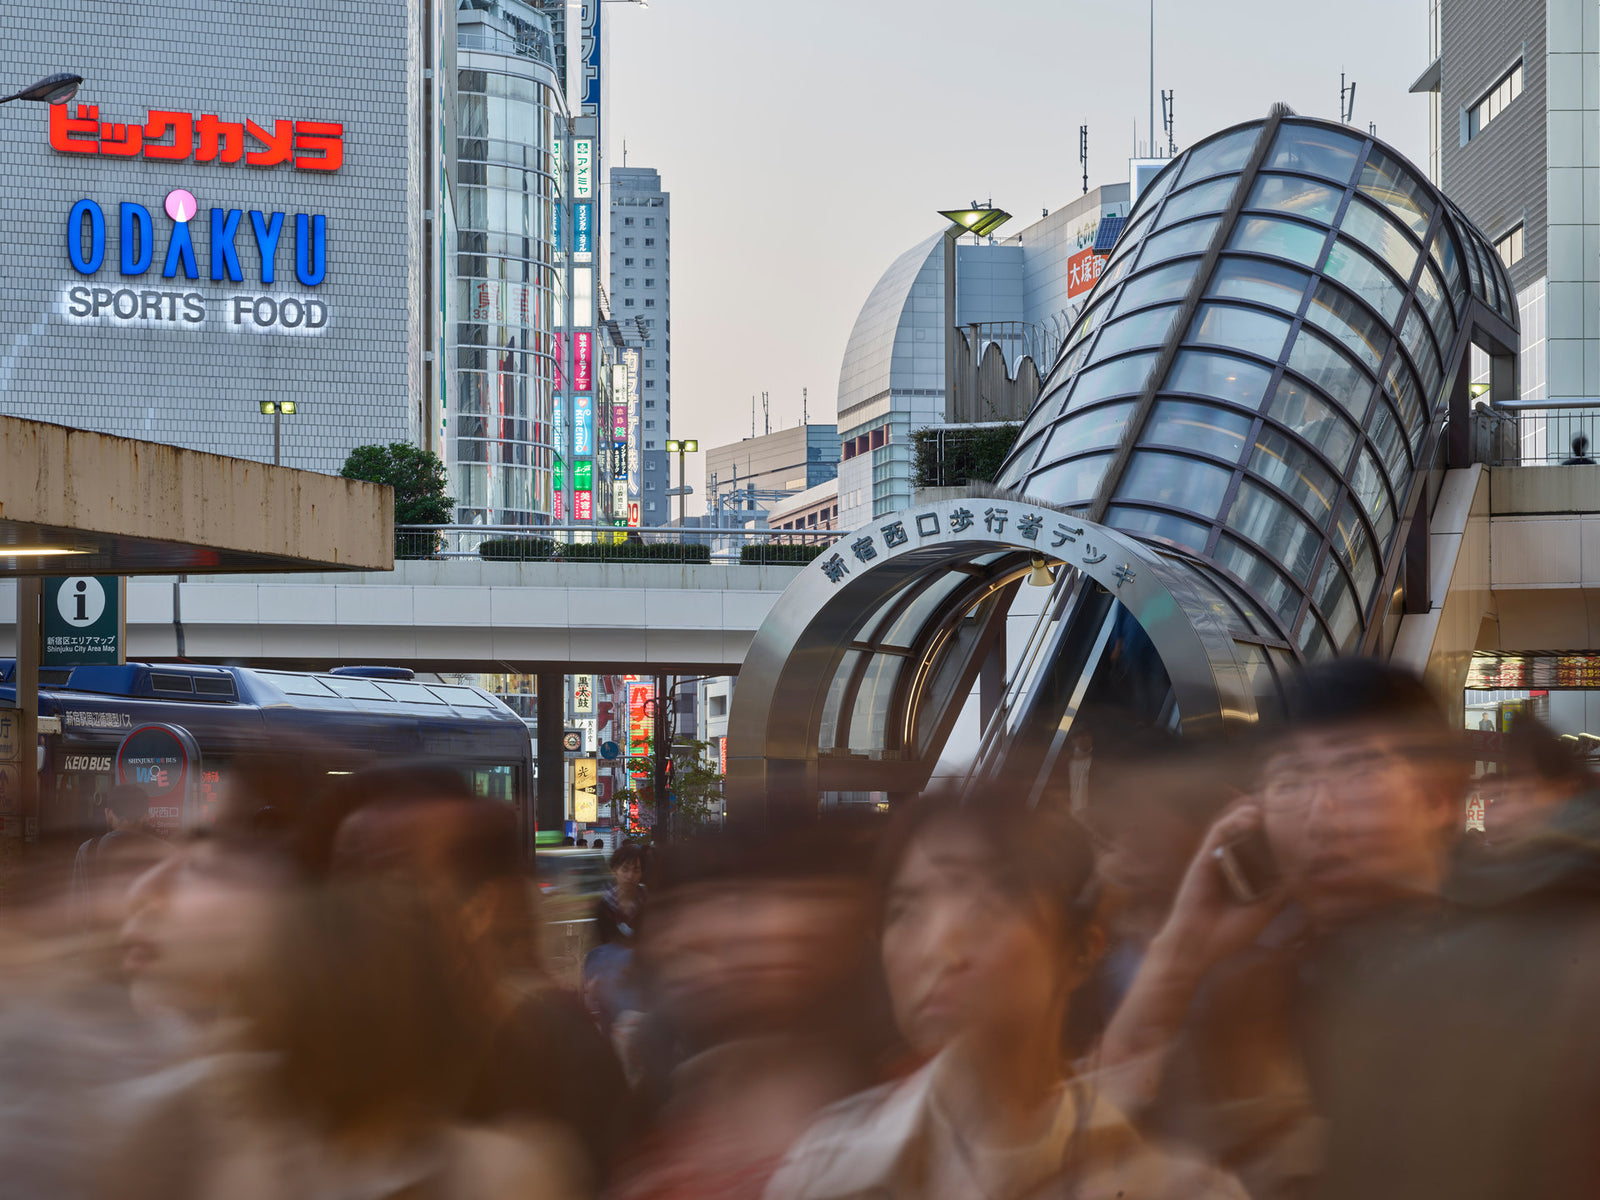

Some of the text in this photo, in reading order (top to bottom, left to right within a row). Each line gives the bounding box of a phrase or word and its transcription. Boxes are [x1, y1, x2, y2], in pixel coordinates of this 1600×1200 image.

[49, 103, 344, 171] ビックカメラ
[577, 157, 589, 195] アメミヤ
[67, 189, 327, 286] ODAKYU
[68, 286, 328, 329] SPORTS FOOD
[575, 409, 584, 453] KIREIMO
[820, 506, 1137, 588] 新宿西口歩行者デッキ
[46, 635, 116, 646] 新宿区エリアマップ
[46, 645, 74, 654] Shinjuku
[74, 645, 87, 654] City
[102, 645, 116, 653] Map
[64, 755, 112, 771] KEIO BUS
